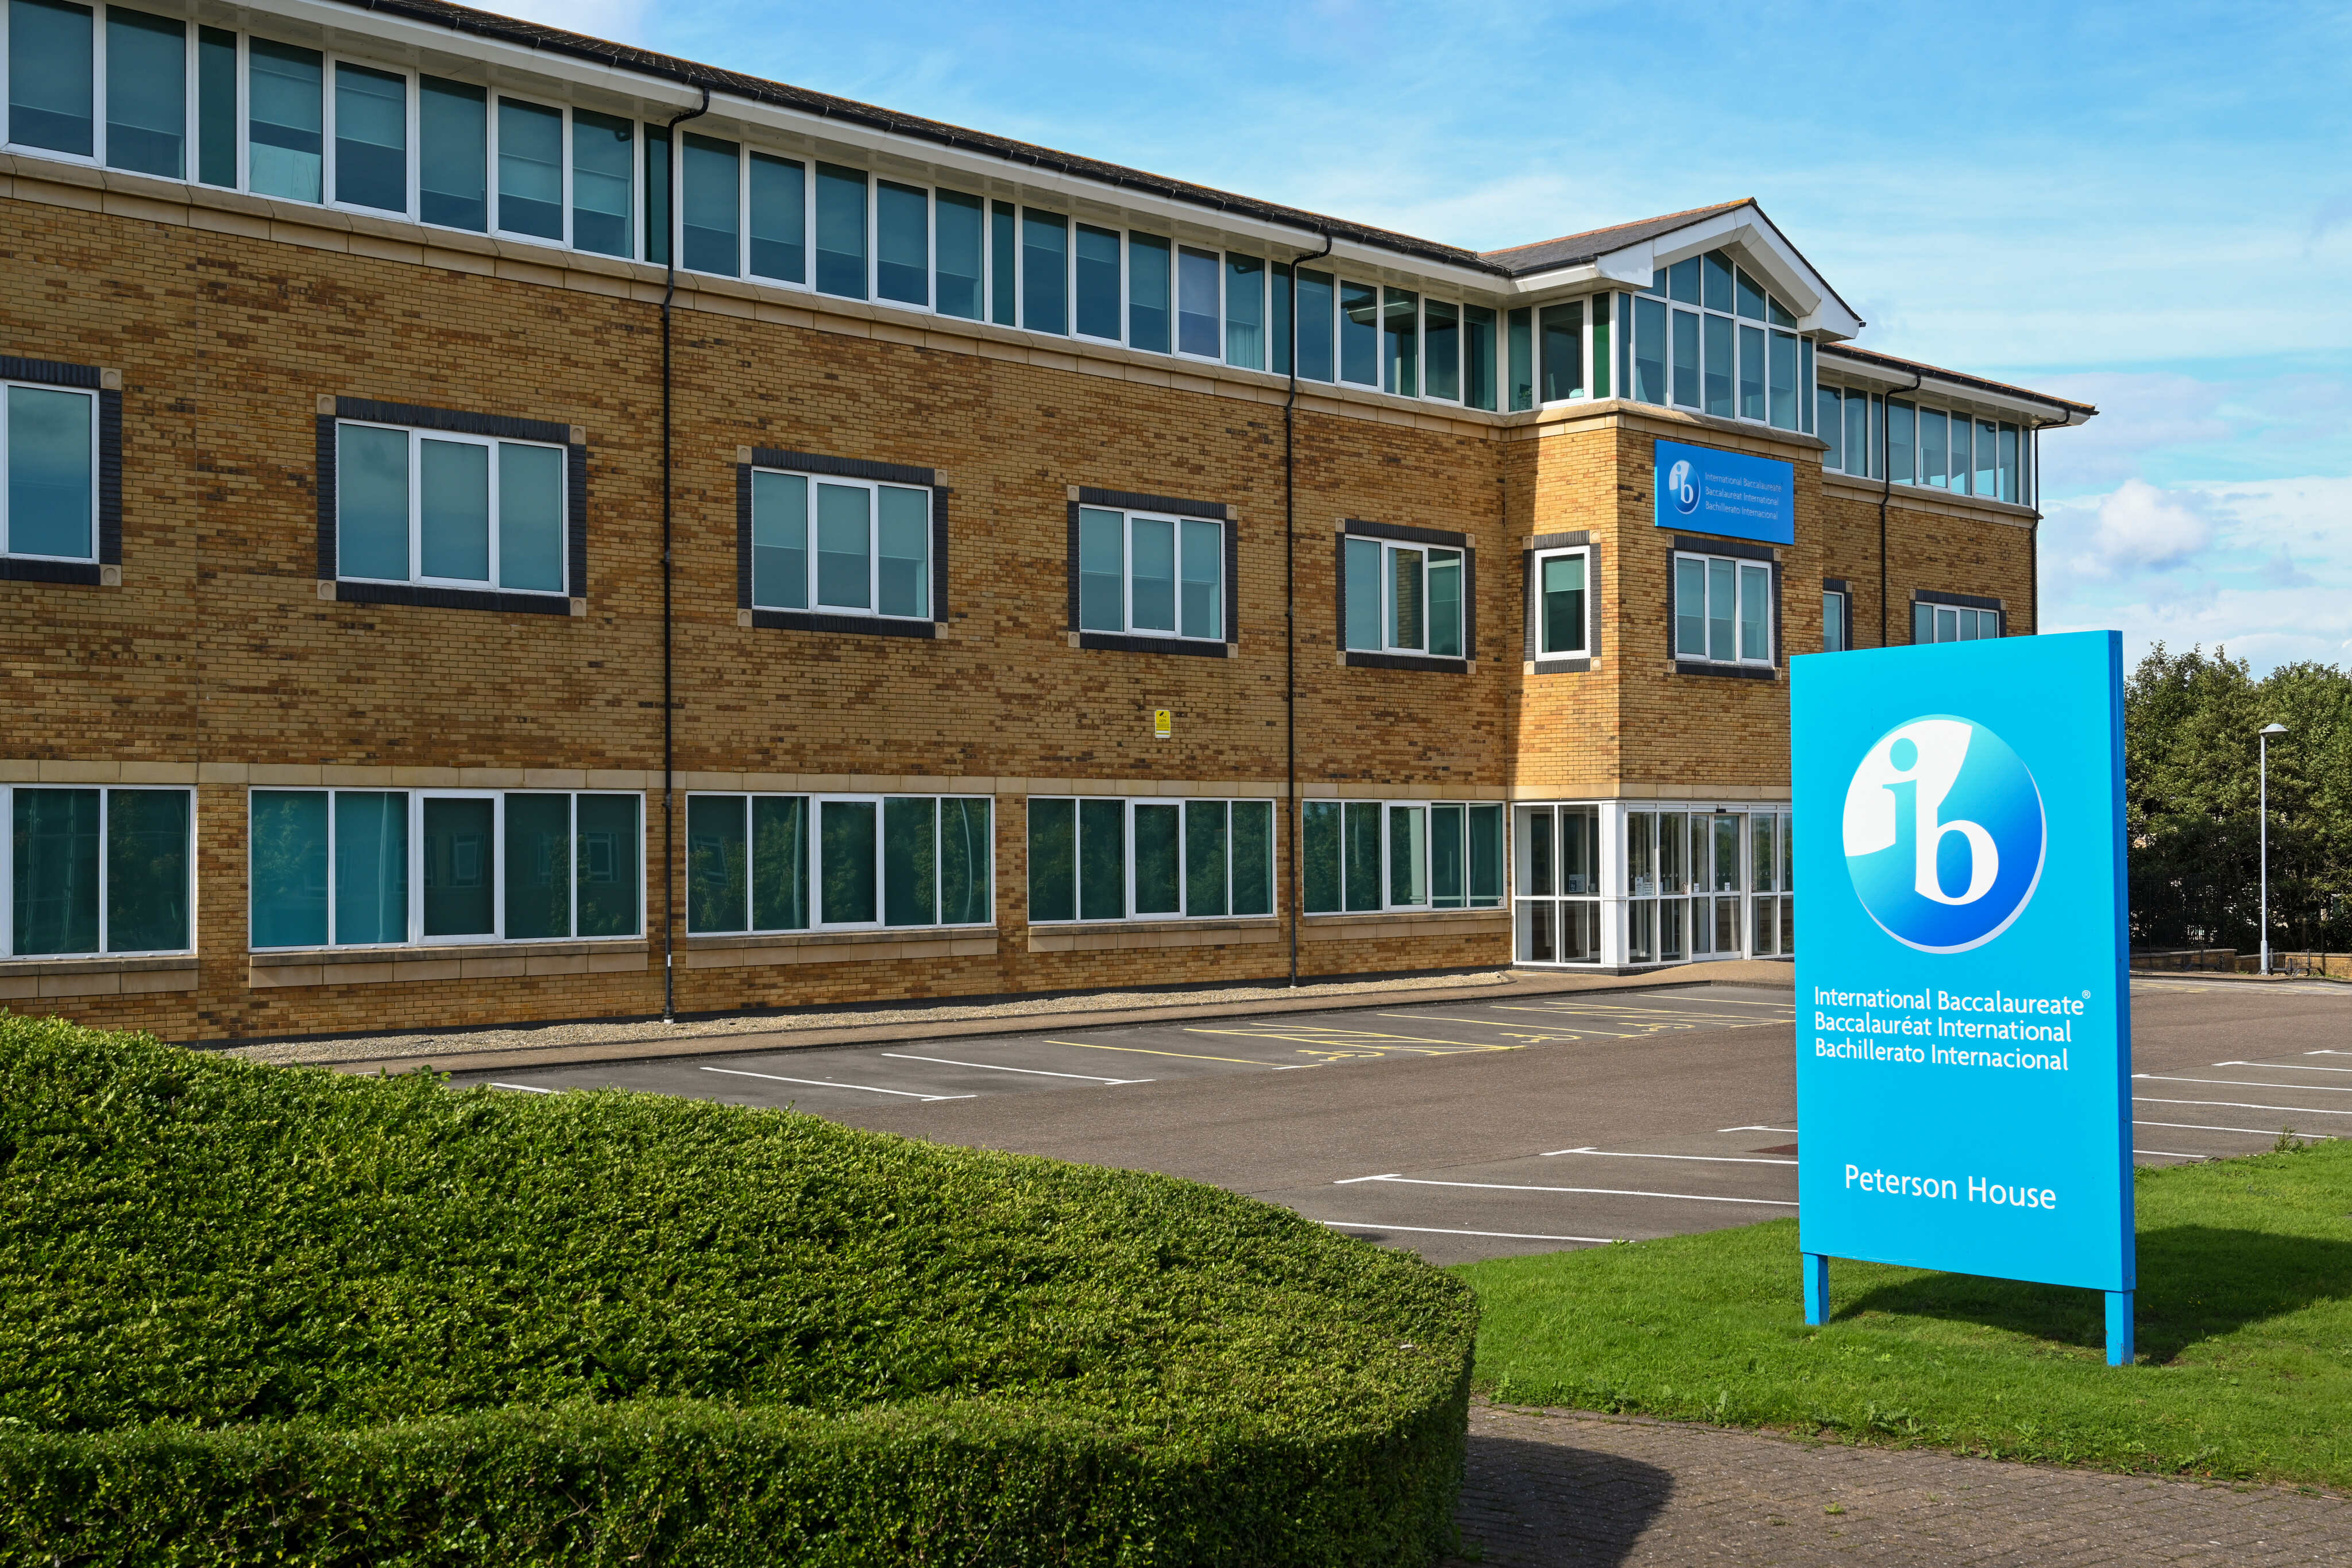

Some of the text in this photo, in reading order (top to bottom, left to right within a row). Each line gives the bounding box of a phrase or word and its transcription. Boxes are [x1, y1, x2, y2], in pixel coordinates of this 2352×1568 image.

[1705, 472, 1742, 486] International
[1705, 500, 1778, 520] Bachillerato Internacional
[1744, 492, 1779, 506] International
[1815, 986, 1931, 1010] International
[1815, 1011, 2072, 1042] Baccalauréat International
[1816, 1037, 2068, 1071] Bachillerato Internacional
[1845, 1164, 2056, 1210] Peterson House
